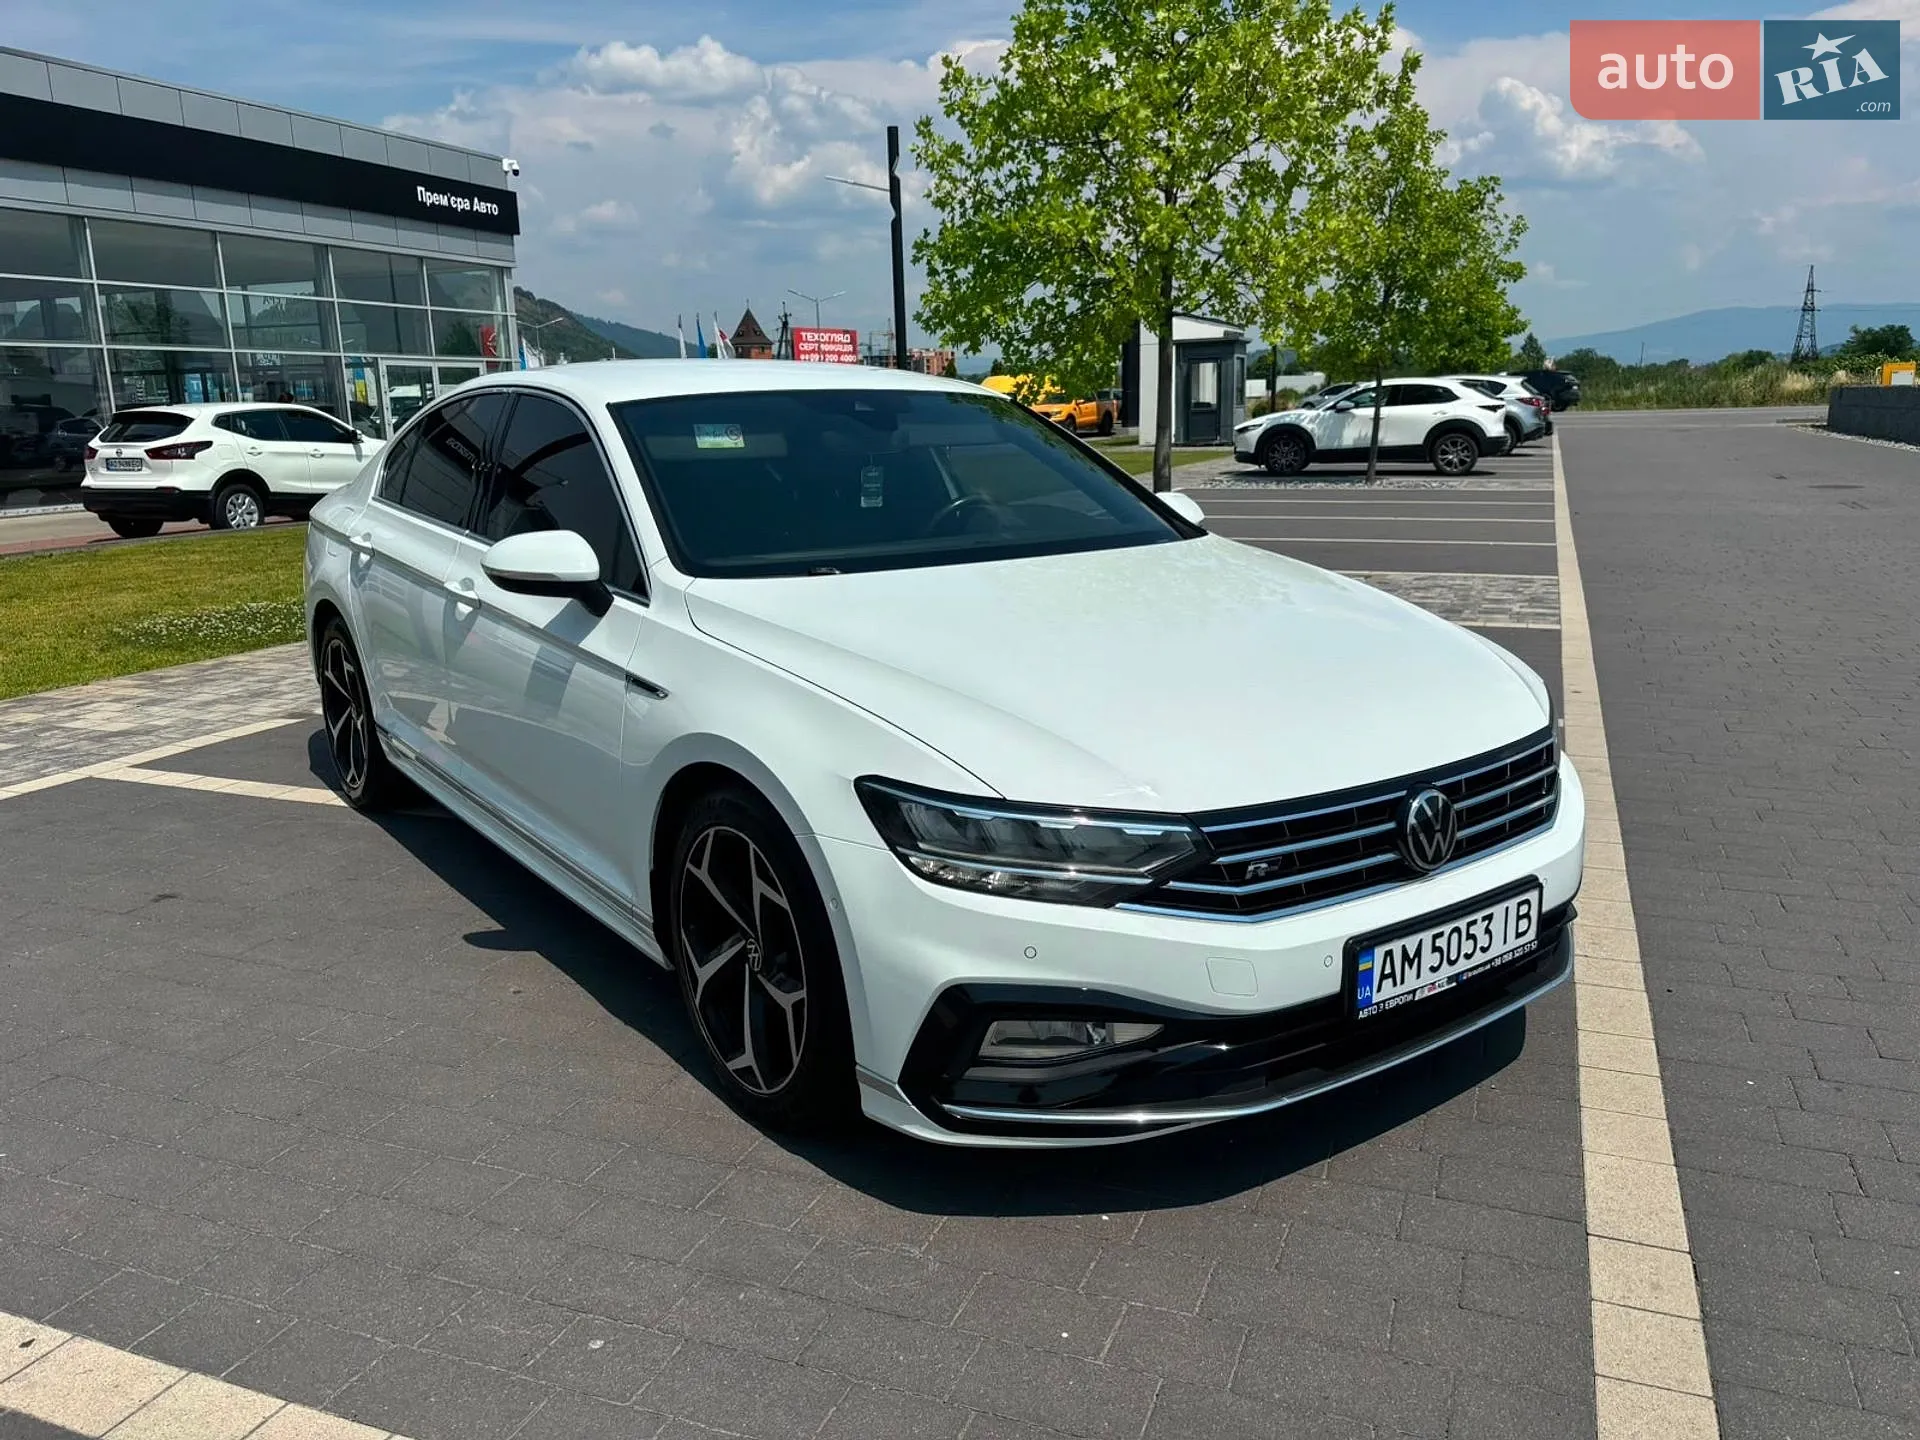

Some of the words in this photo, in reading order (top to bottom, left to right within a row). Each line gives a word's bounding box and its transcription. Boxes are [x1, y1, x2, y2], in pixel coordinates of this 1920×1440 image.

[416, 186, 471, 212] Прем'єра
[472, 196, 499, 216] Авто
[1376, 938, 1424, 994] AM
[1429, 912, 1494, 974] 5053
[1502, 898, 1532, 946] IB
[1357, 985, 1372, 1000] UA
